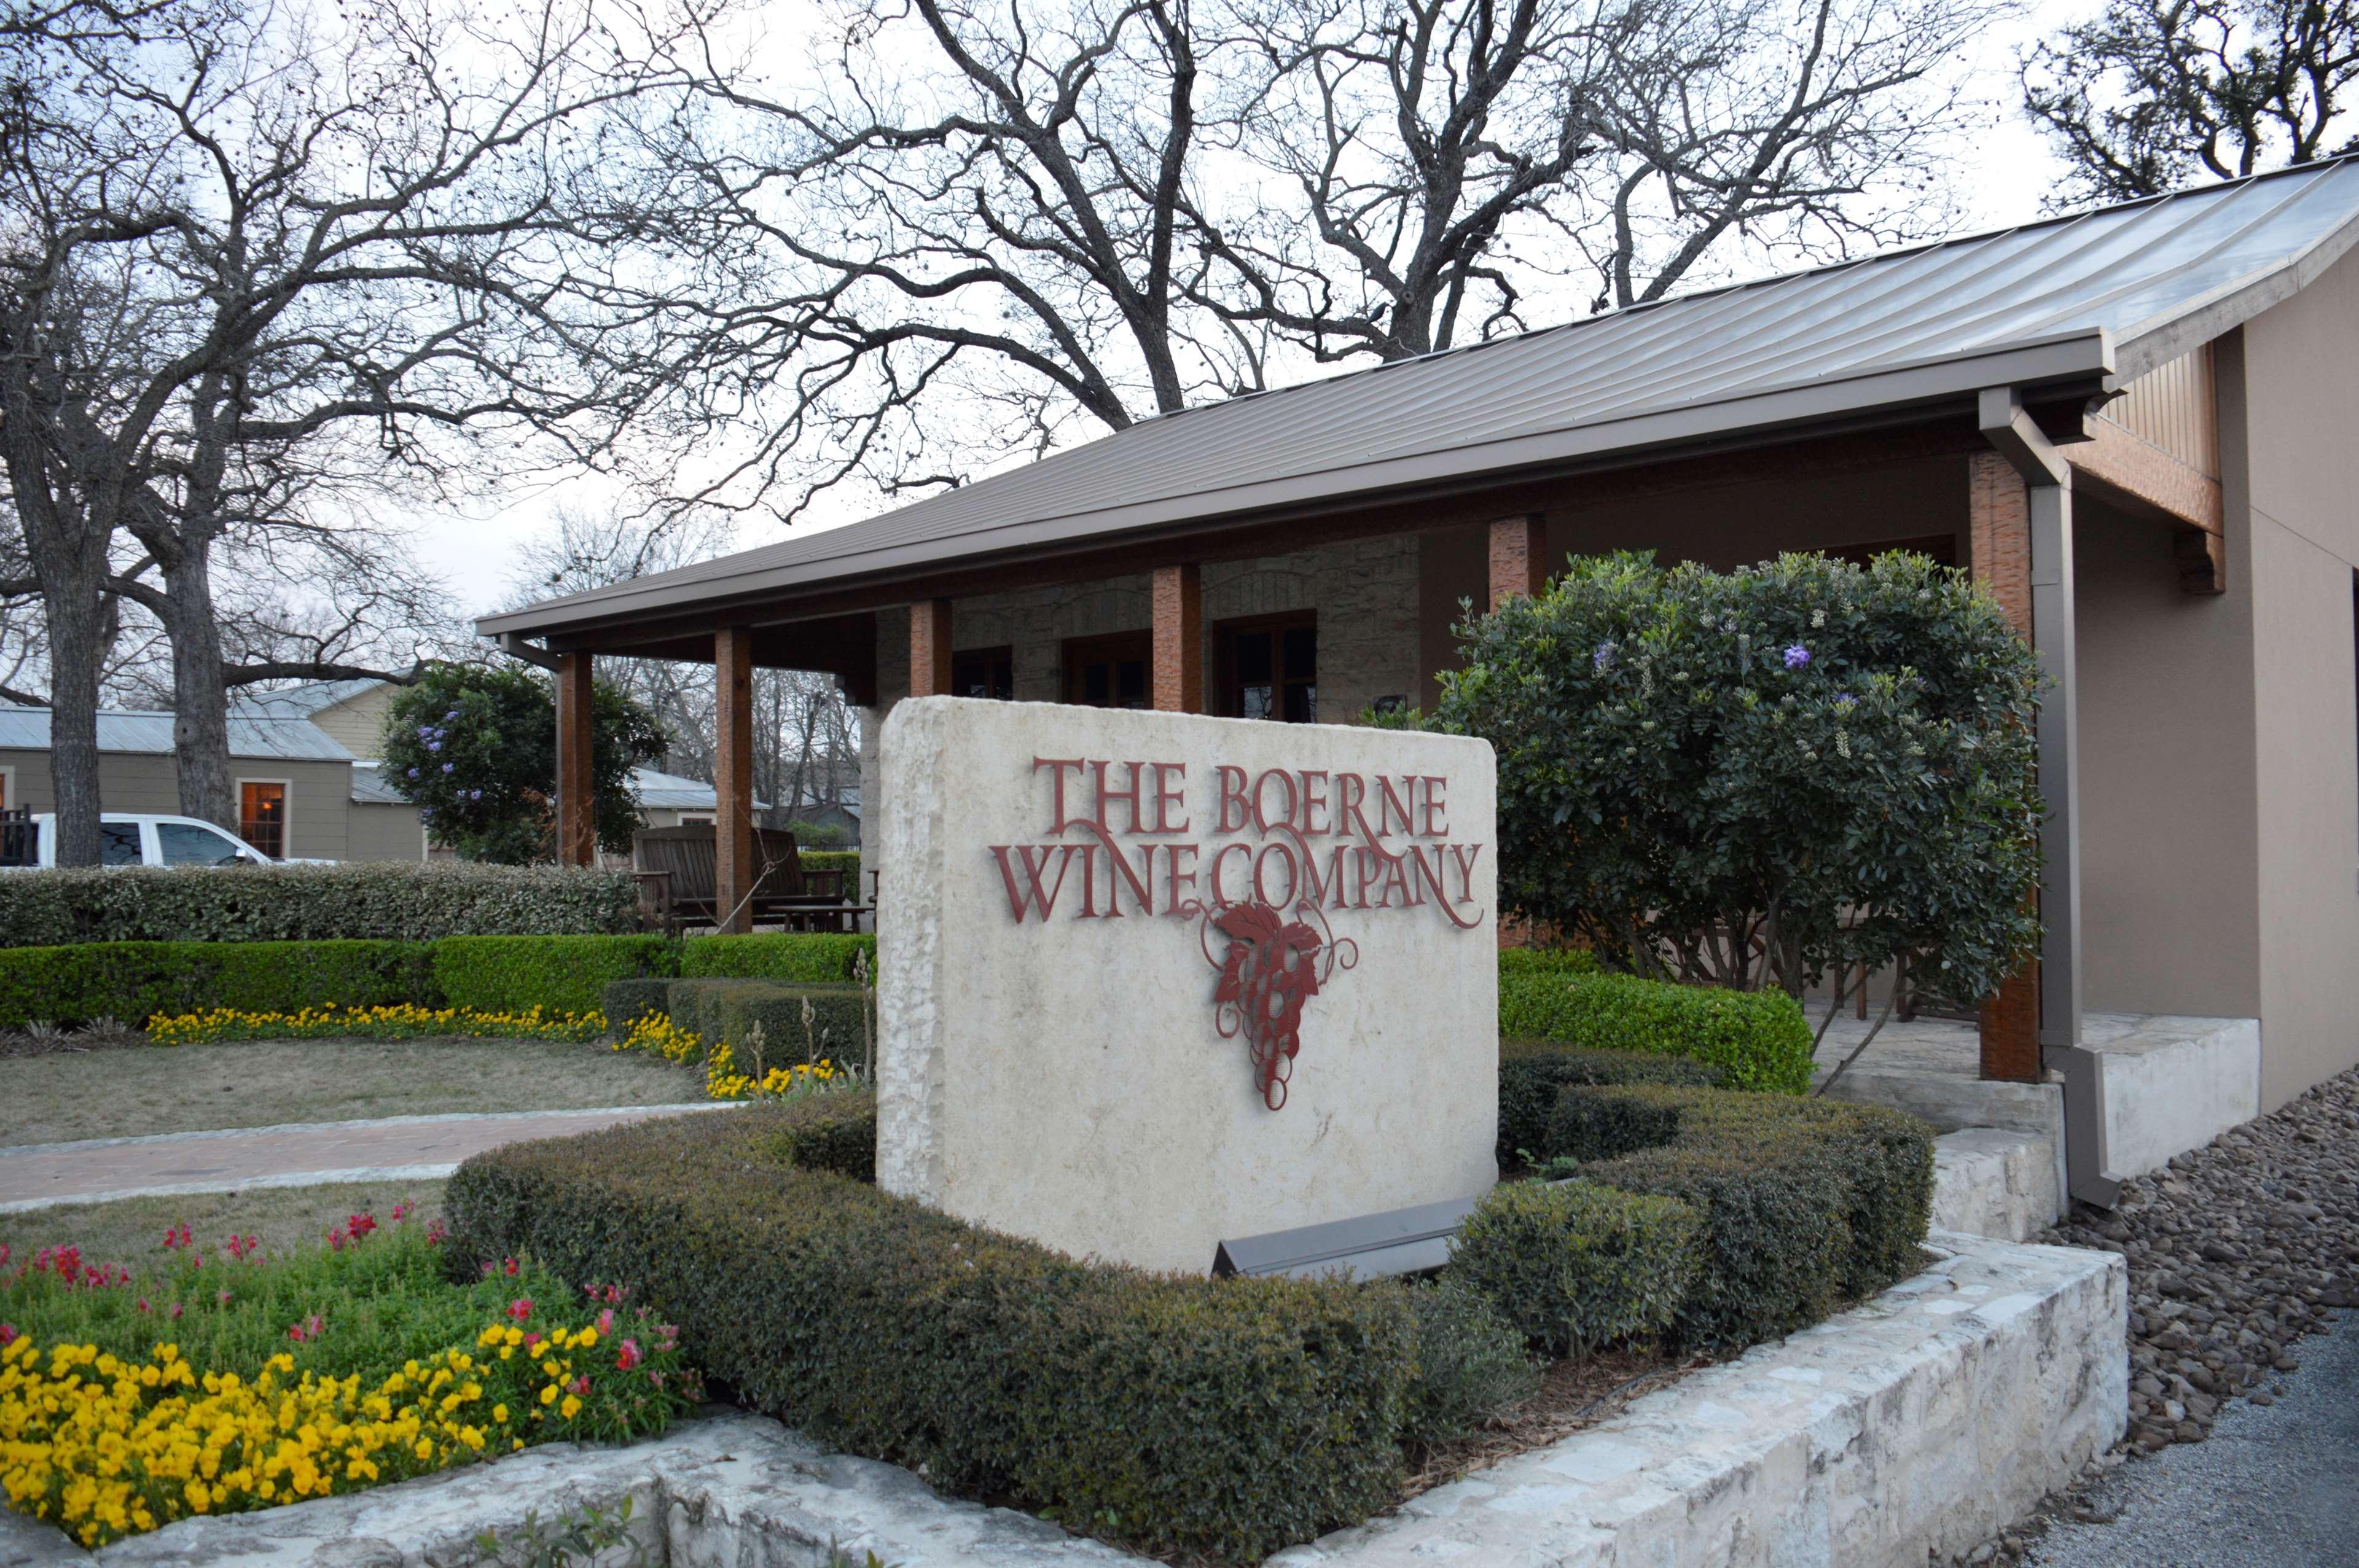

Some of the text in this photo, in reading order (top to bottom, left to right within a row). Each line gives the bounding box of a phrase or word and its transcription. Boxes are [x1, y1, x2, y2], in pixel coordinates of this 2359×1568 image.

[1033, 756, 1450, 860] THE BOERNE
[988, 818, 1484, 929] WINE COMPANY
